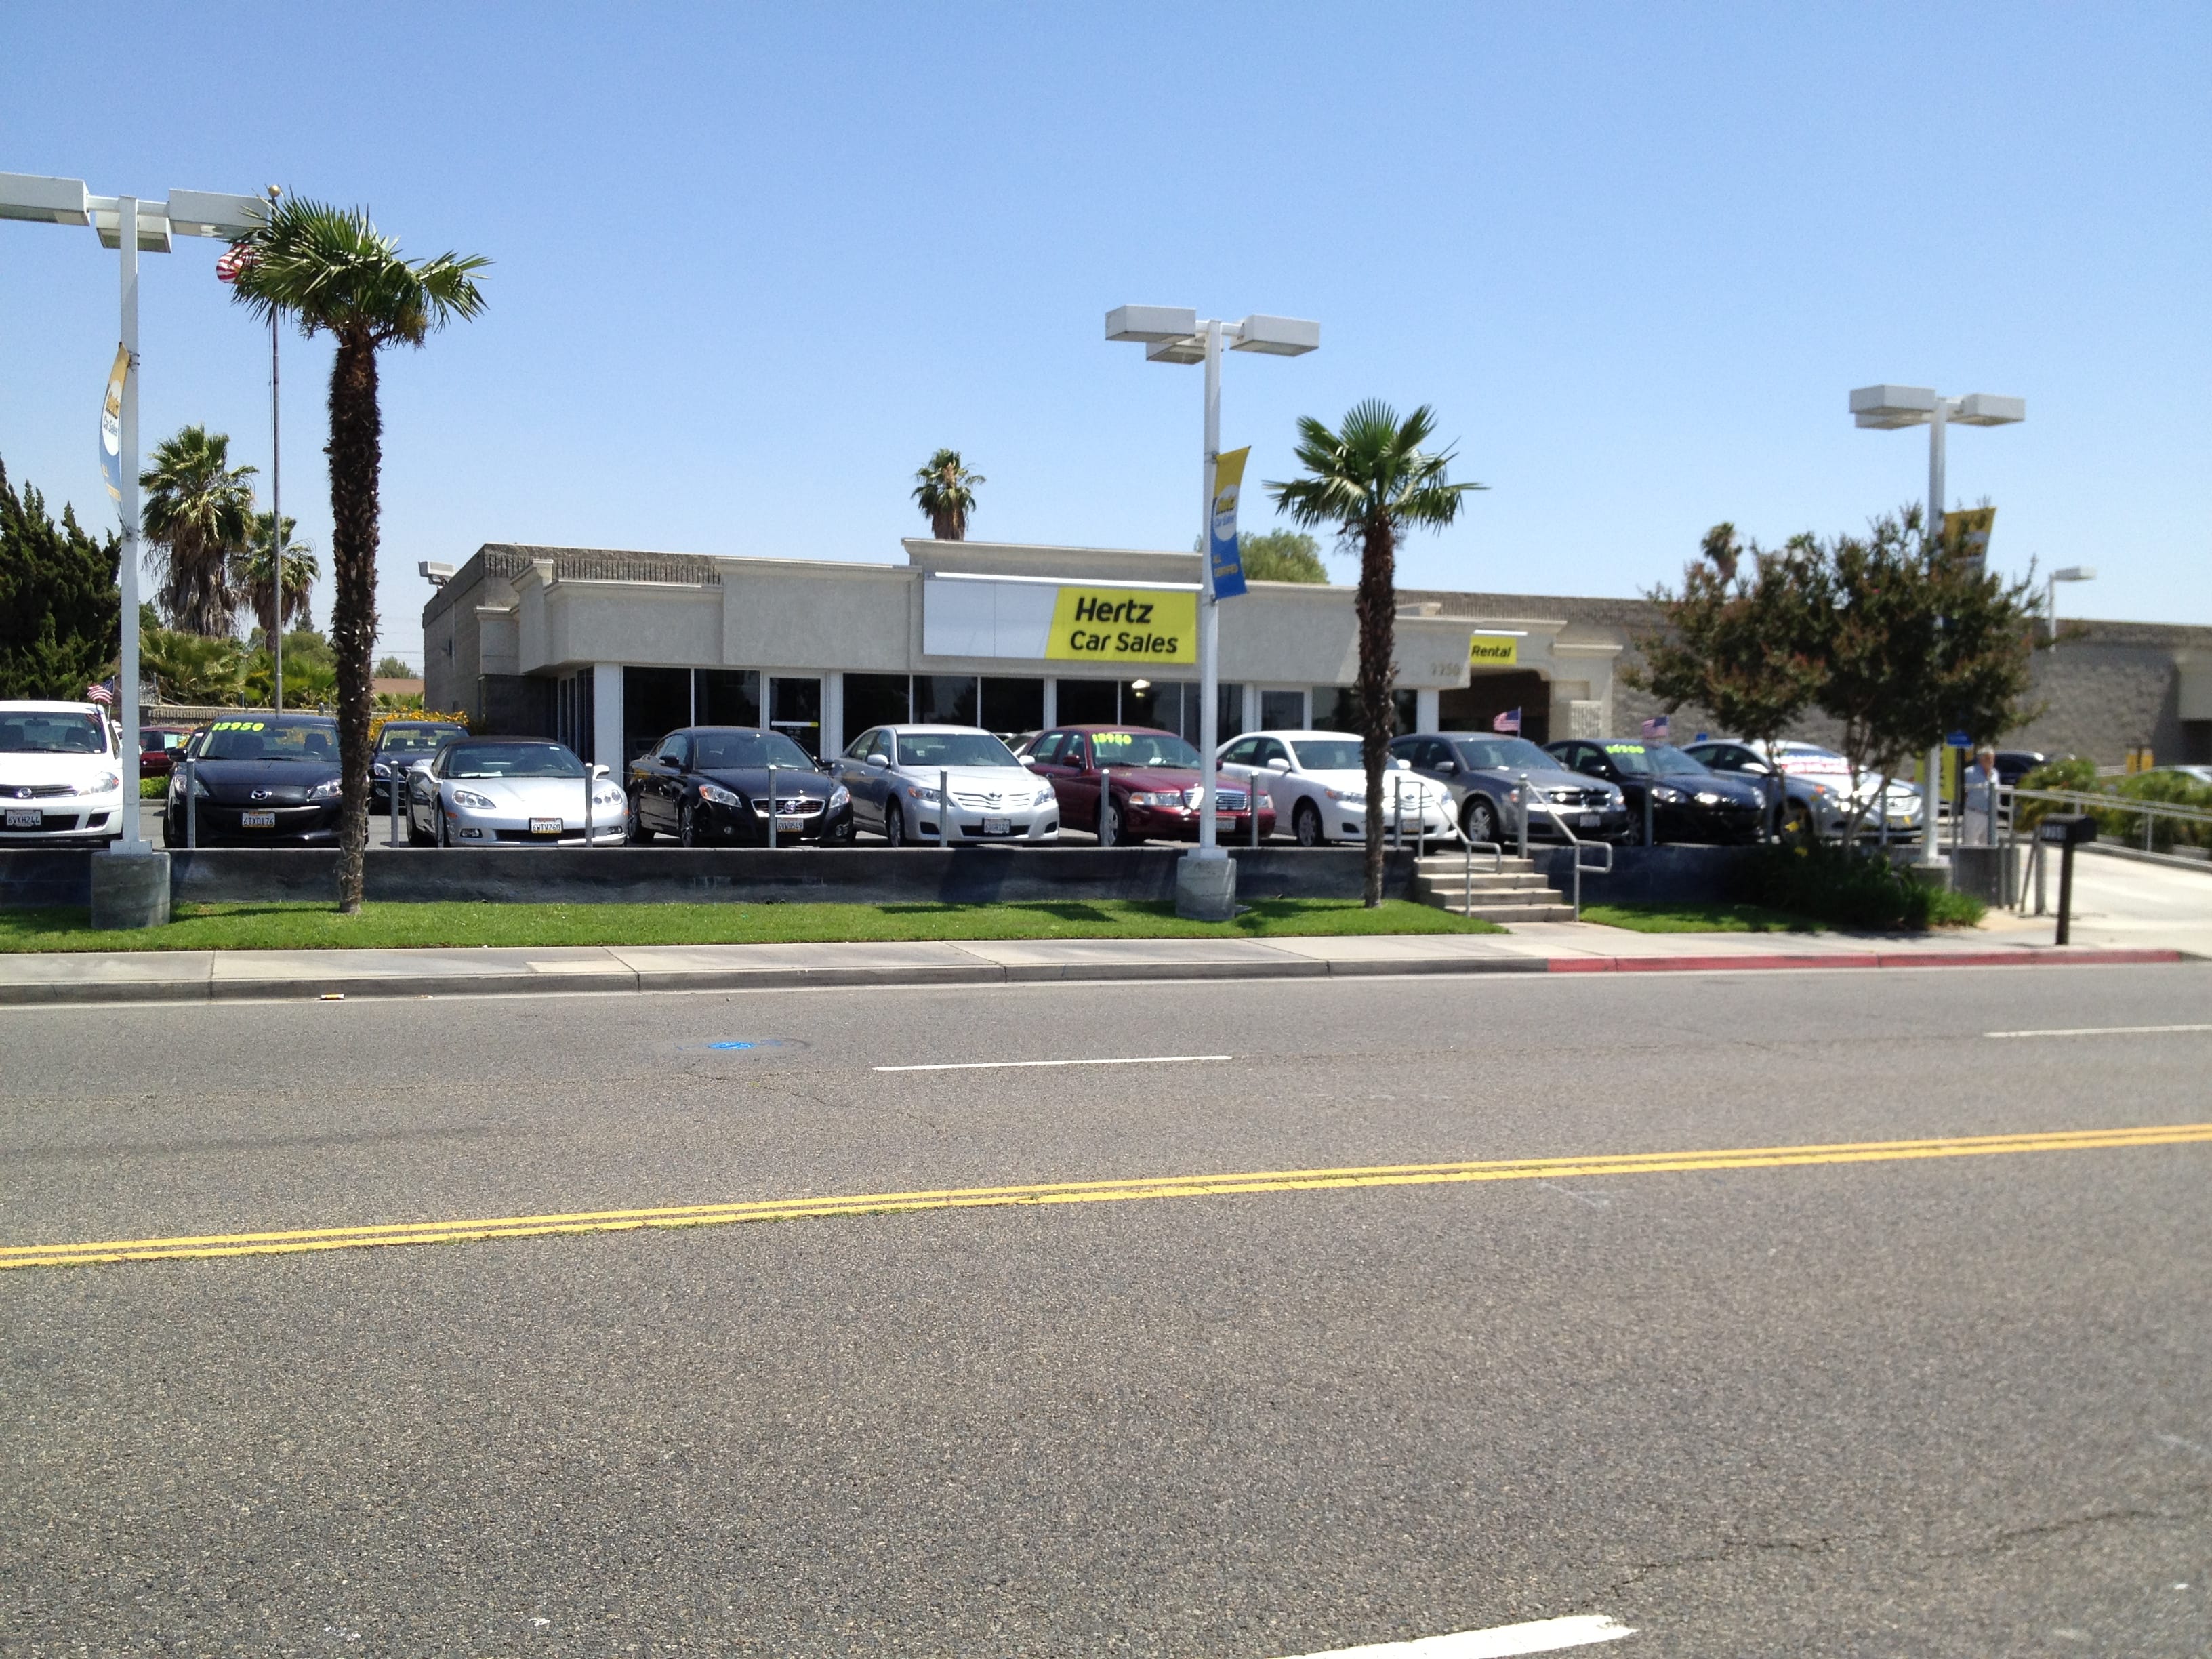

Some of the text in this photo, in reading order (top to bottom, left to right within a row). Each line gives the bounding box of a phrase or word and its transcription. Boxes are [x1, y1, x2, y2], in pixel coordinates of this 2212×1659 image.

[1075, 597, 1153, 624] Hertz
[1070, 630, 1179, 653] Car Sales
[1471, 644, 1512, 658] Rental
